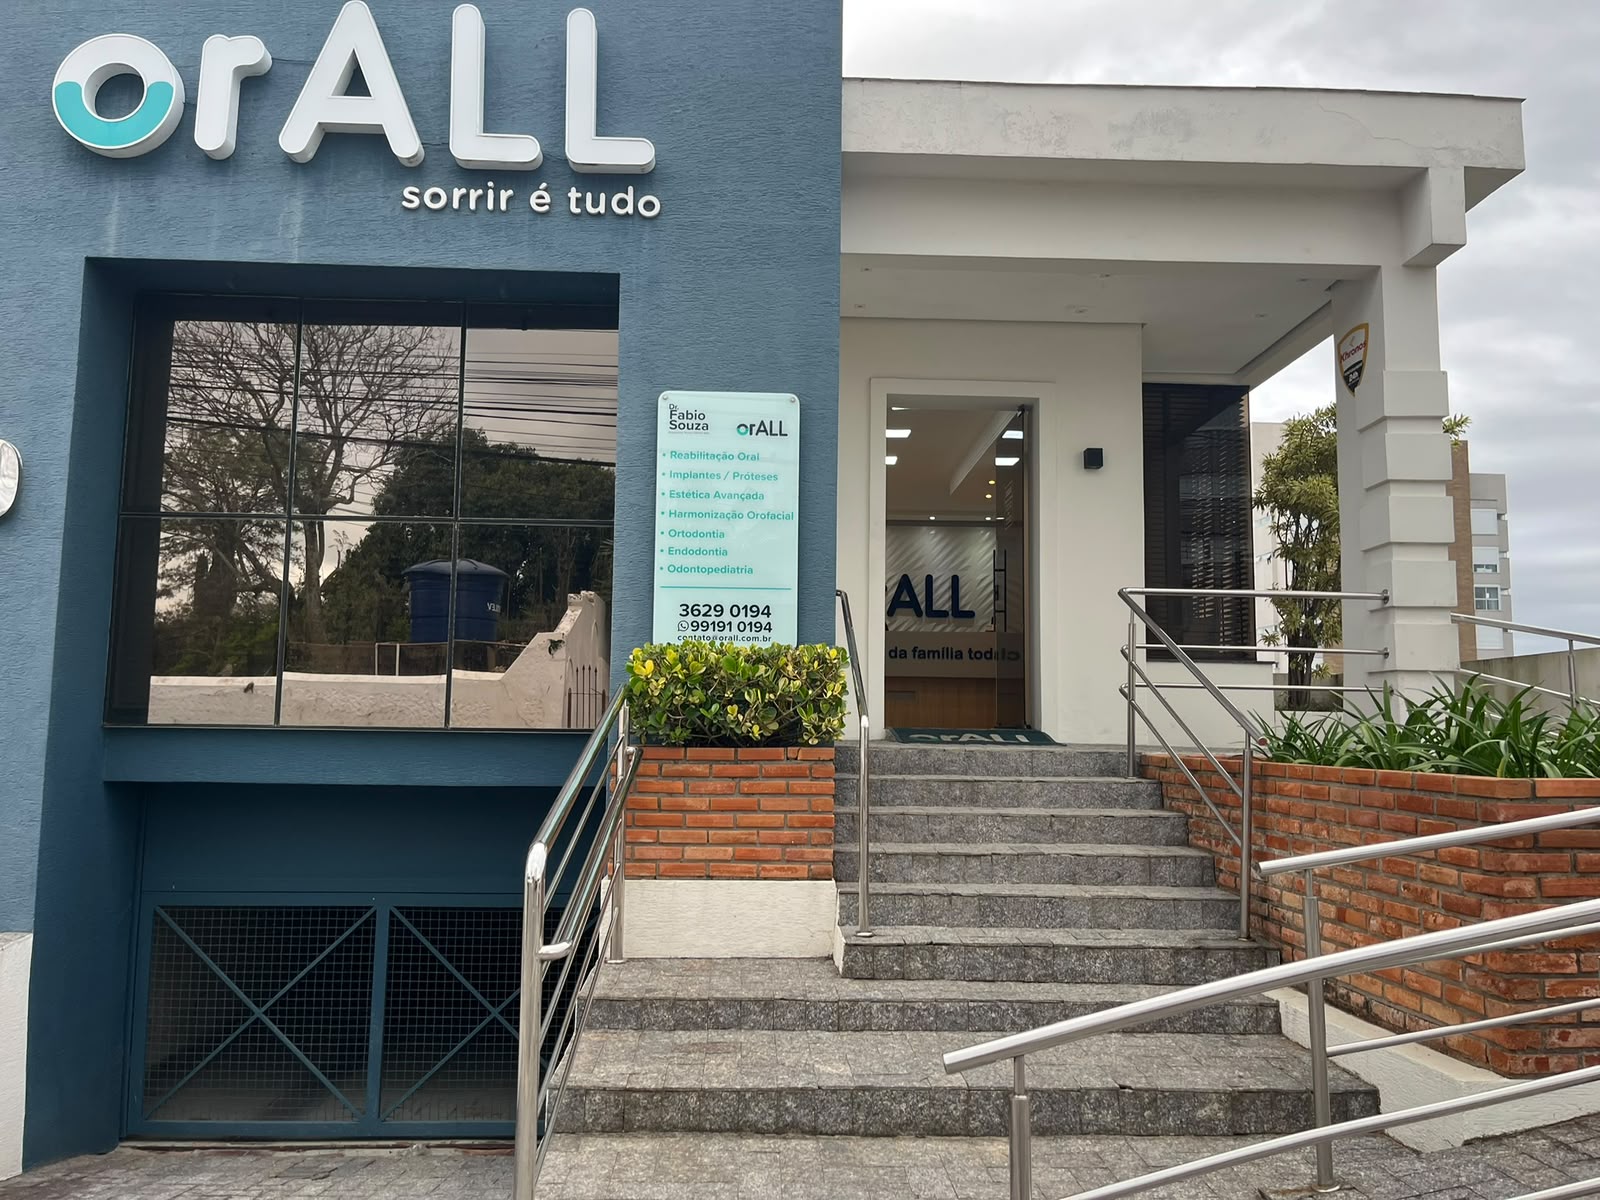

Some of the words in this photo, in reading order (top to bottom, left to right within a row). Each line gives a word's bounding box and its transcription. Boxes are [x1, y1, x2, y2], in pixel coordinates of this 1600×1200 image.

[52, 0, 656, 174] orALL
[401, 181, 514, 212] sorrir
[529, 182, 552, 213] é
[567, 185, 662, 218] tudo
[668, 403, 680, 411] Dr.
[669, 409, 706, 421] Fabio
[668, 420, 709, 431] Souza
[736, 420, 789, 437] orALL
[670, 450, 735, 462] Reabilitação
[737, 452, 760, 462] Oral
[669, 470, 722, 482] Implantes
[732, 471, 779, 482] Próteses
[669, 489, 711, 500] Estética
[713, 490, 765, 502] Avançada
[668, 509, 744, 521] Harmonização
[746, 510, 795, 521] Orofacial
[668, 528, 725, 539] Ortodontia
[667, 546, 728, 557] Endodontia
[667, 564, 754, 576] Odontopediatria
[885, 573, 976, 619] ALL
[679, 603, 725, 618] 3629
[729, 604, 772, 619] 0194
[690, 620, 733, 633] 99191
[737, 621, 773, 634] 0194
[888, 646, 908, 660] da
[911, 646, 964, 660] família
